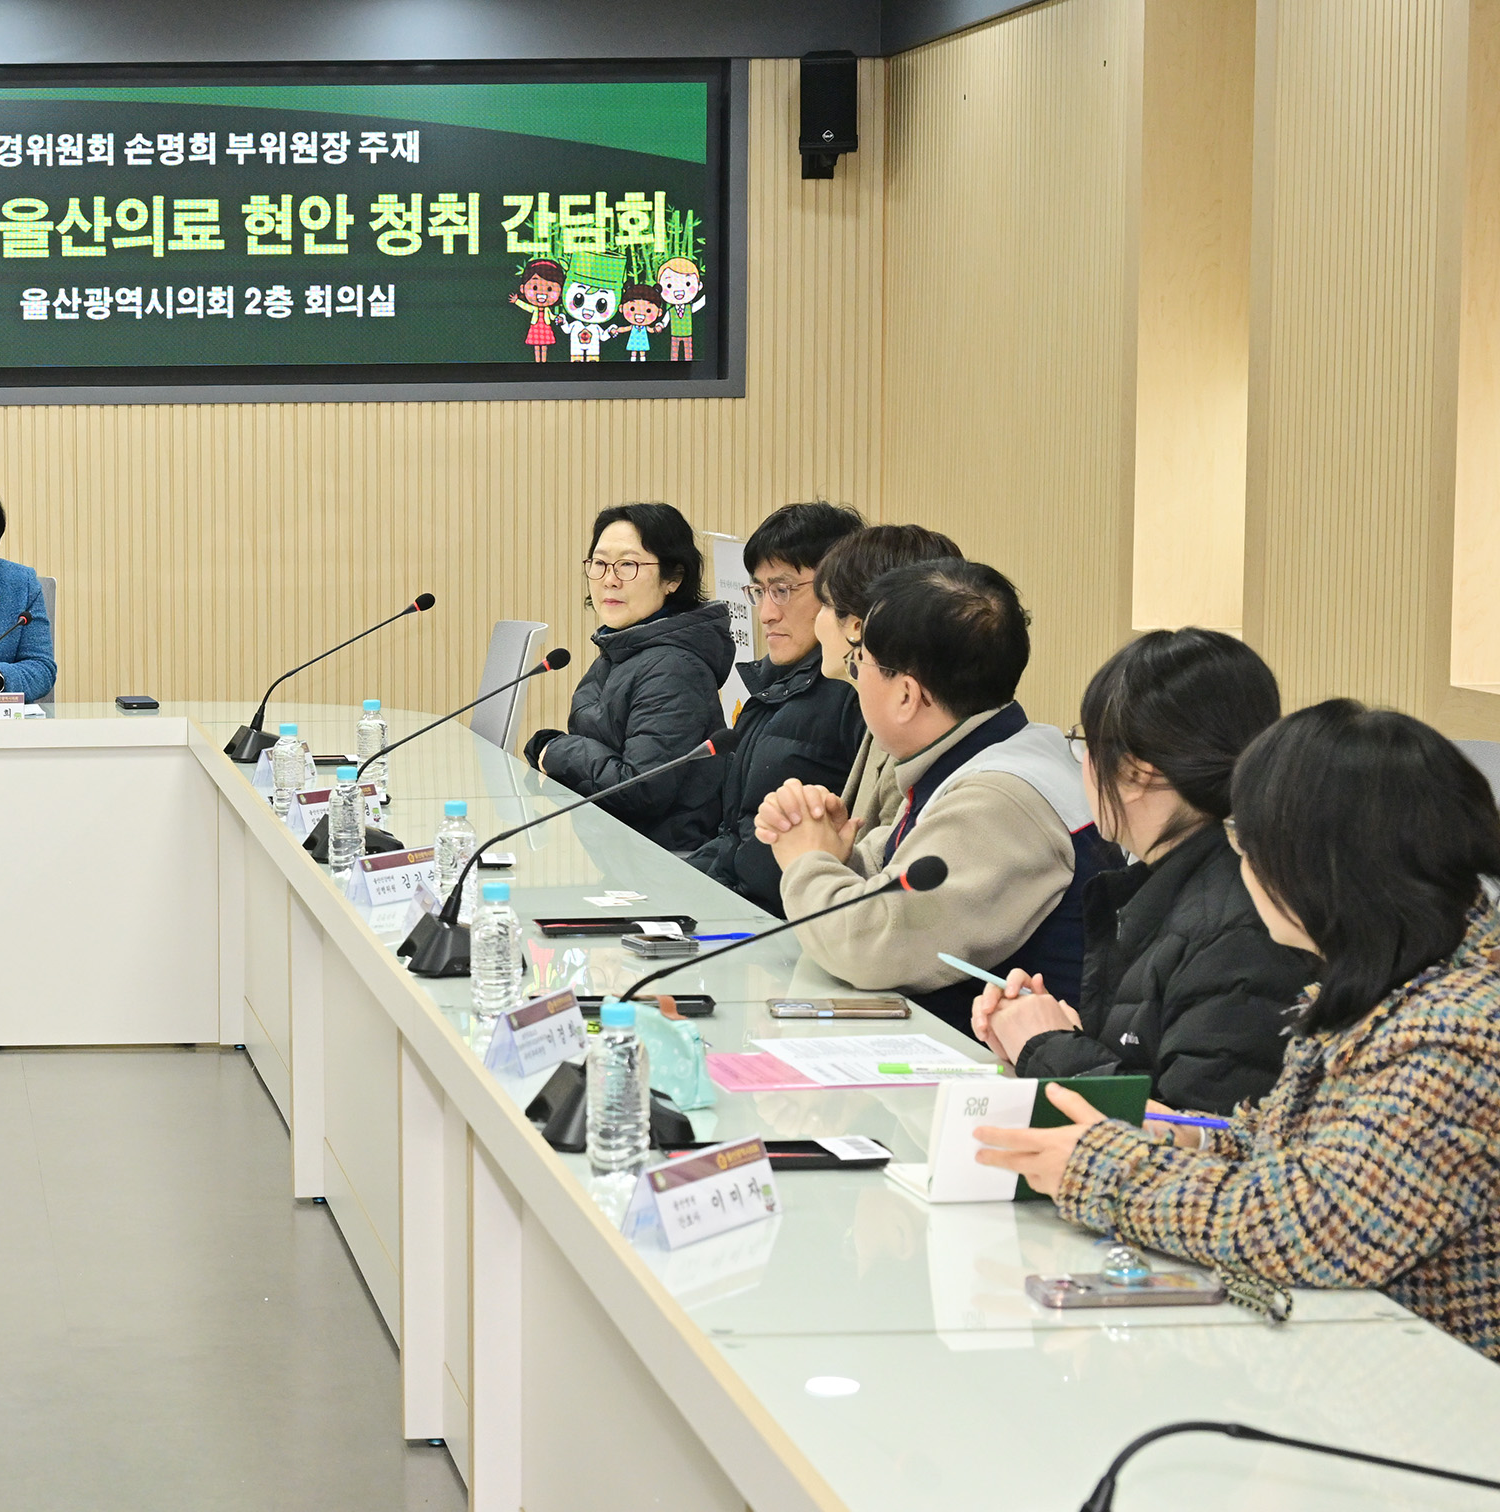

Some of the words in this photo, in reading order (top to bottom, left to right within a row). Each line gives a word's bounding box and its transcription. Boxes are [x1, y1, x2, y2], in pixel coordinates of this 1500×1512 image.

[124, 131, 216, 166] 손명희
[225, 130, 351, 165] 부위원장
[358, 129, 420, 164] 주재
[241, 193, 355, 256] 현안
[368, 192, 480, 256] 청취
[500, 190, 667, 255] 간담회
[19, 285, 234, 321] 울산광역시의회
[244, 285, 294, 319] 2층
[304, 283, 396, 318] 회의실
